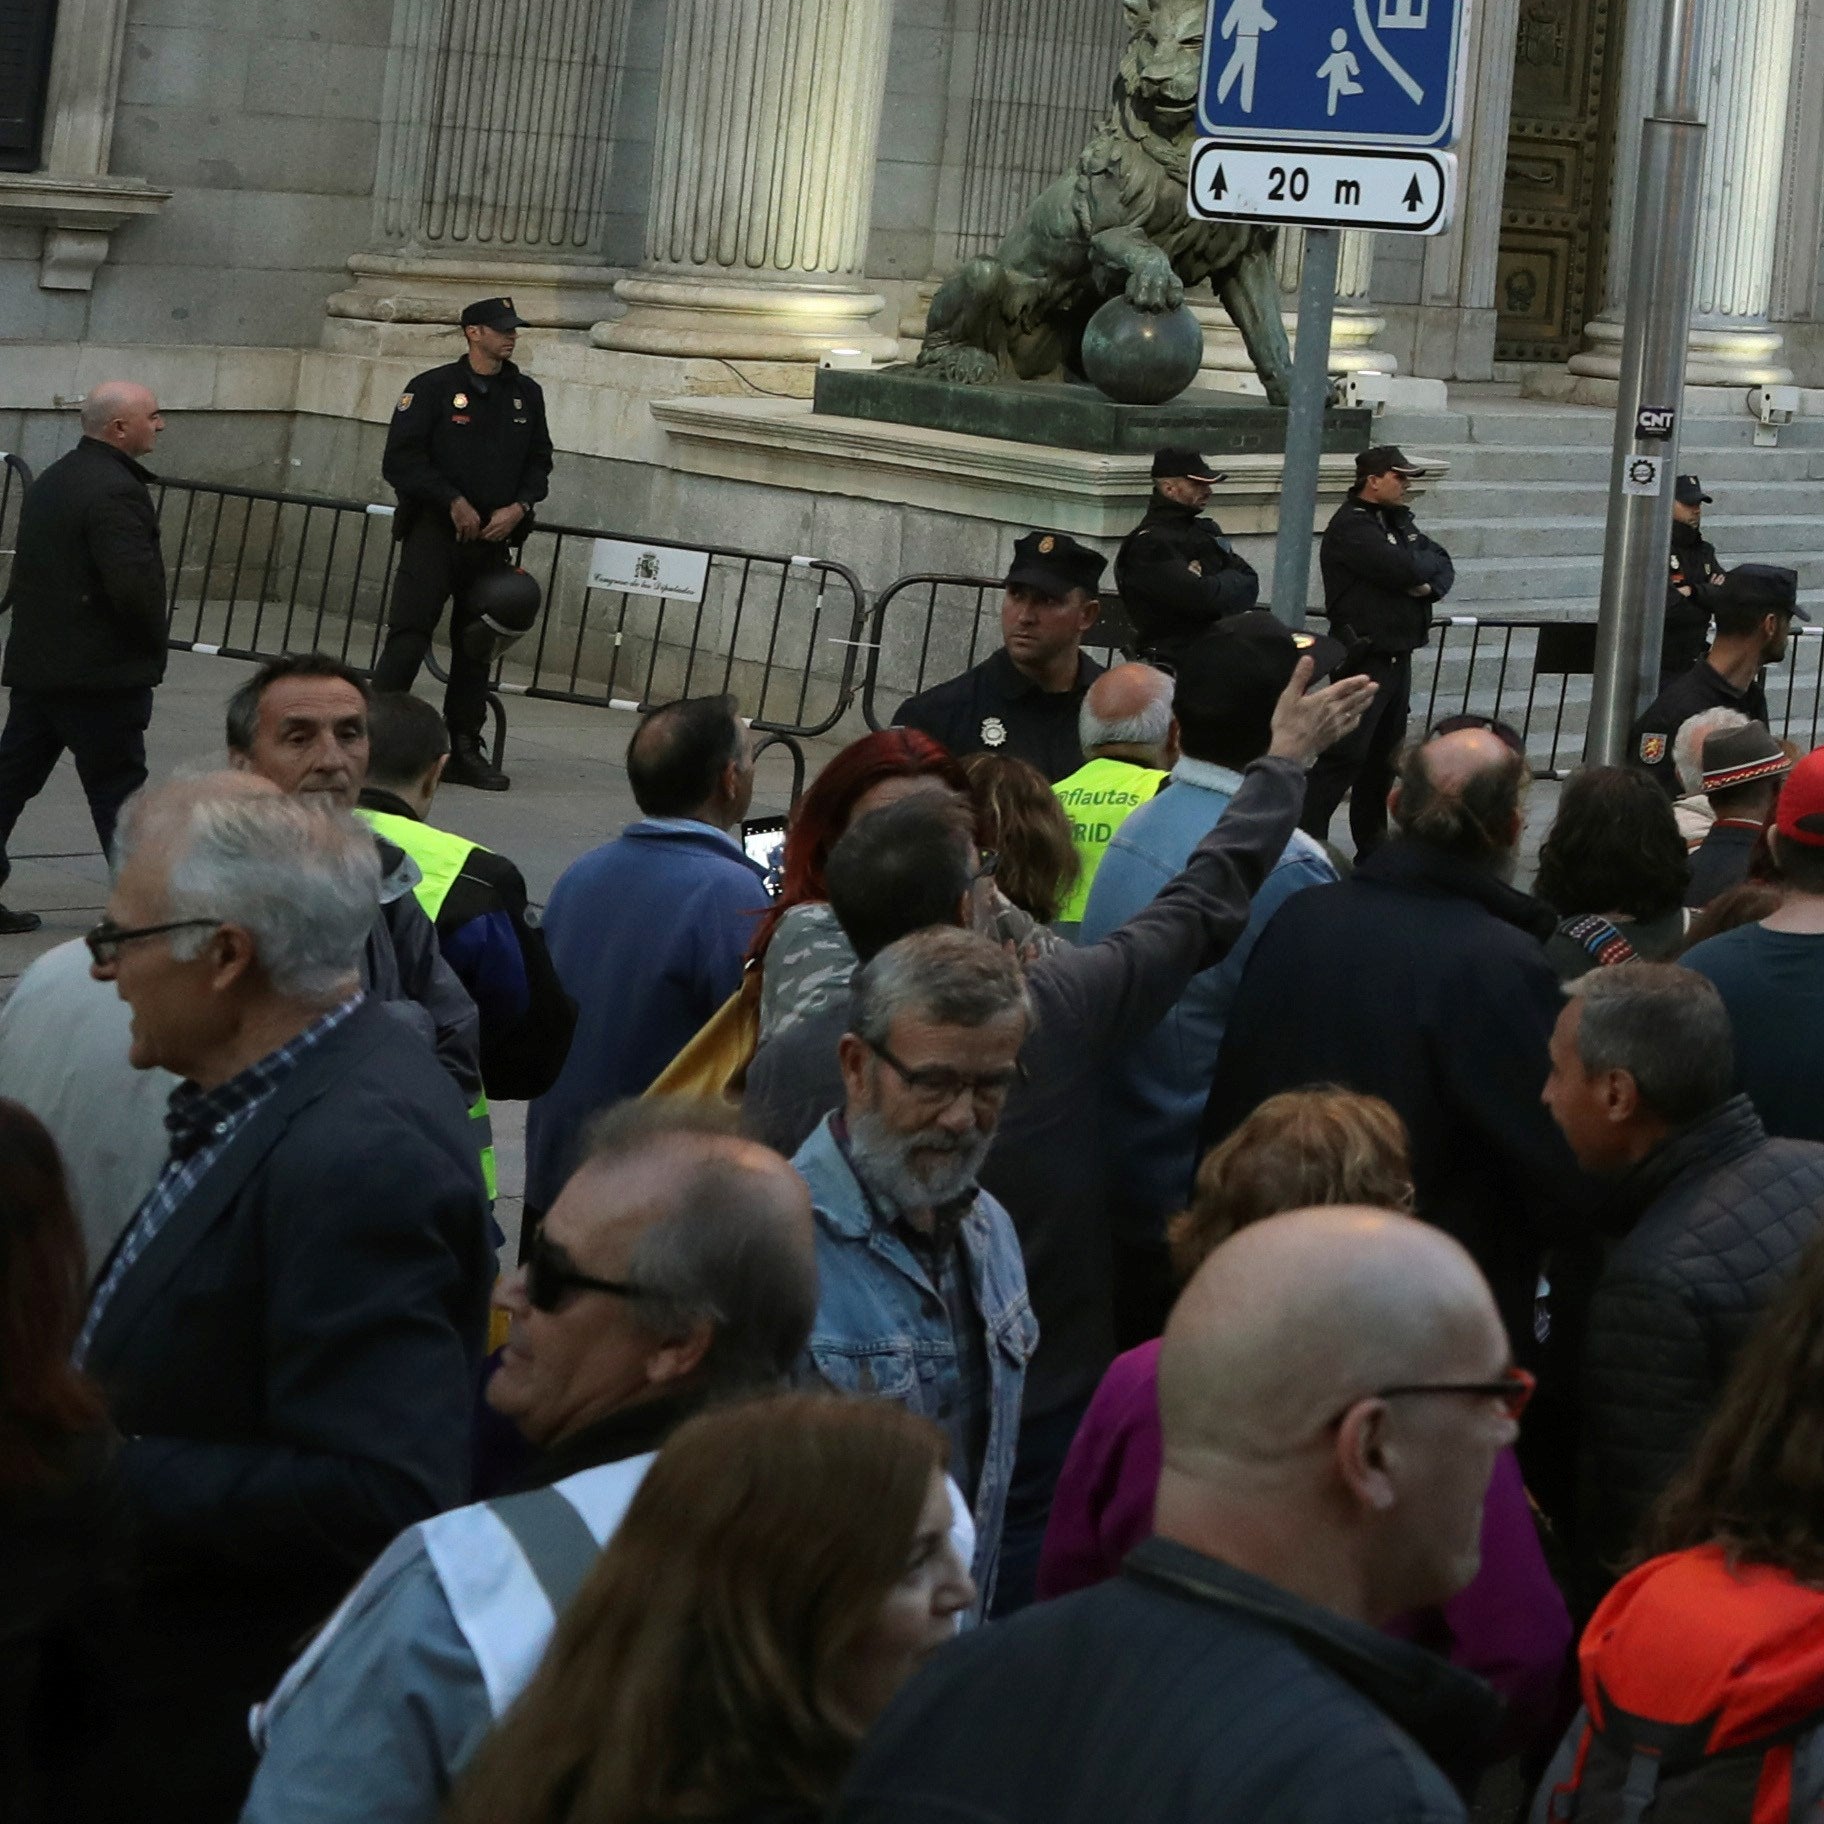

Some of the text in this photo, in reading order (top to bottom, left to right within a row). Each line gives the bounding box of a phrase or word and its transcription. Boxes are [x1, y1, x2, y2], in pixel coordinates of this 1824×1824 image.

[1268, 166, 1360, 206] 20 m
[1640, 411, 1674, 428] CNT
[1072, 822, 1112, 843] RID
